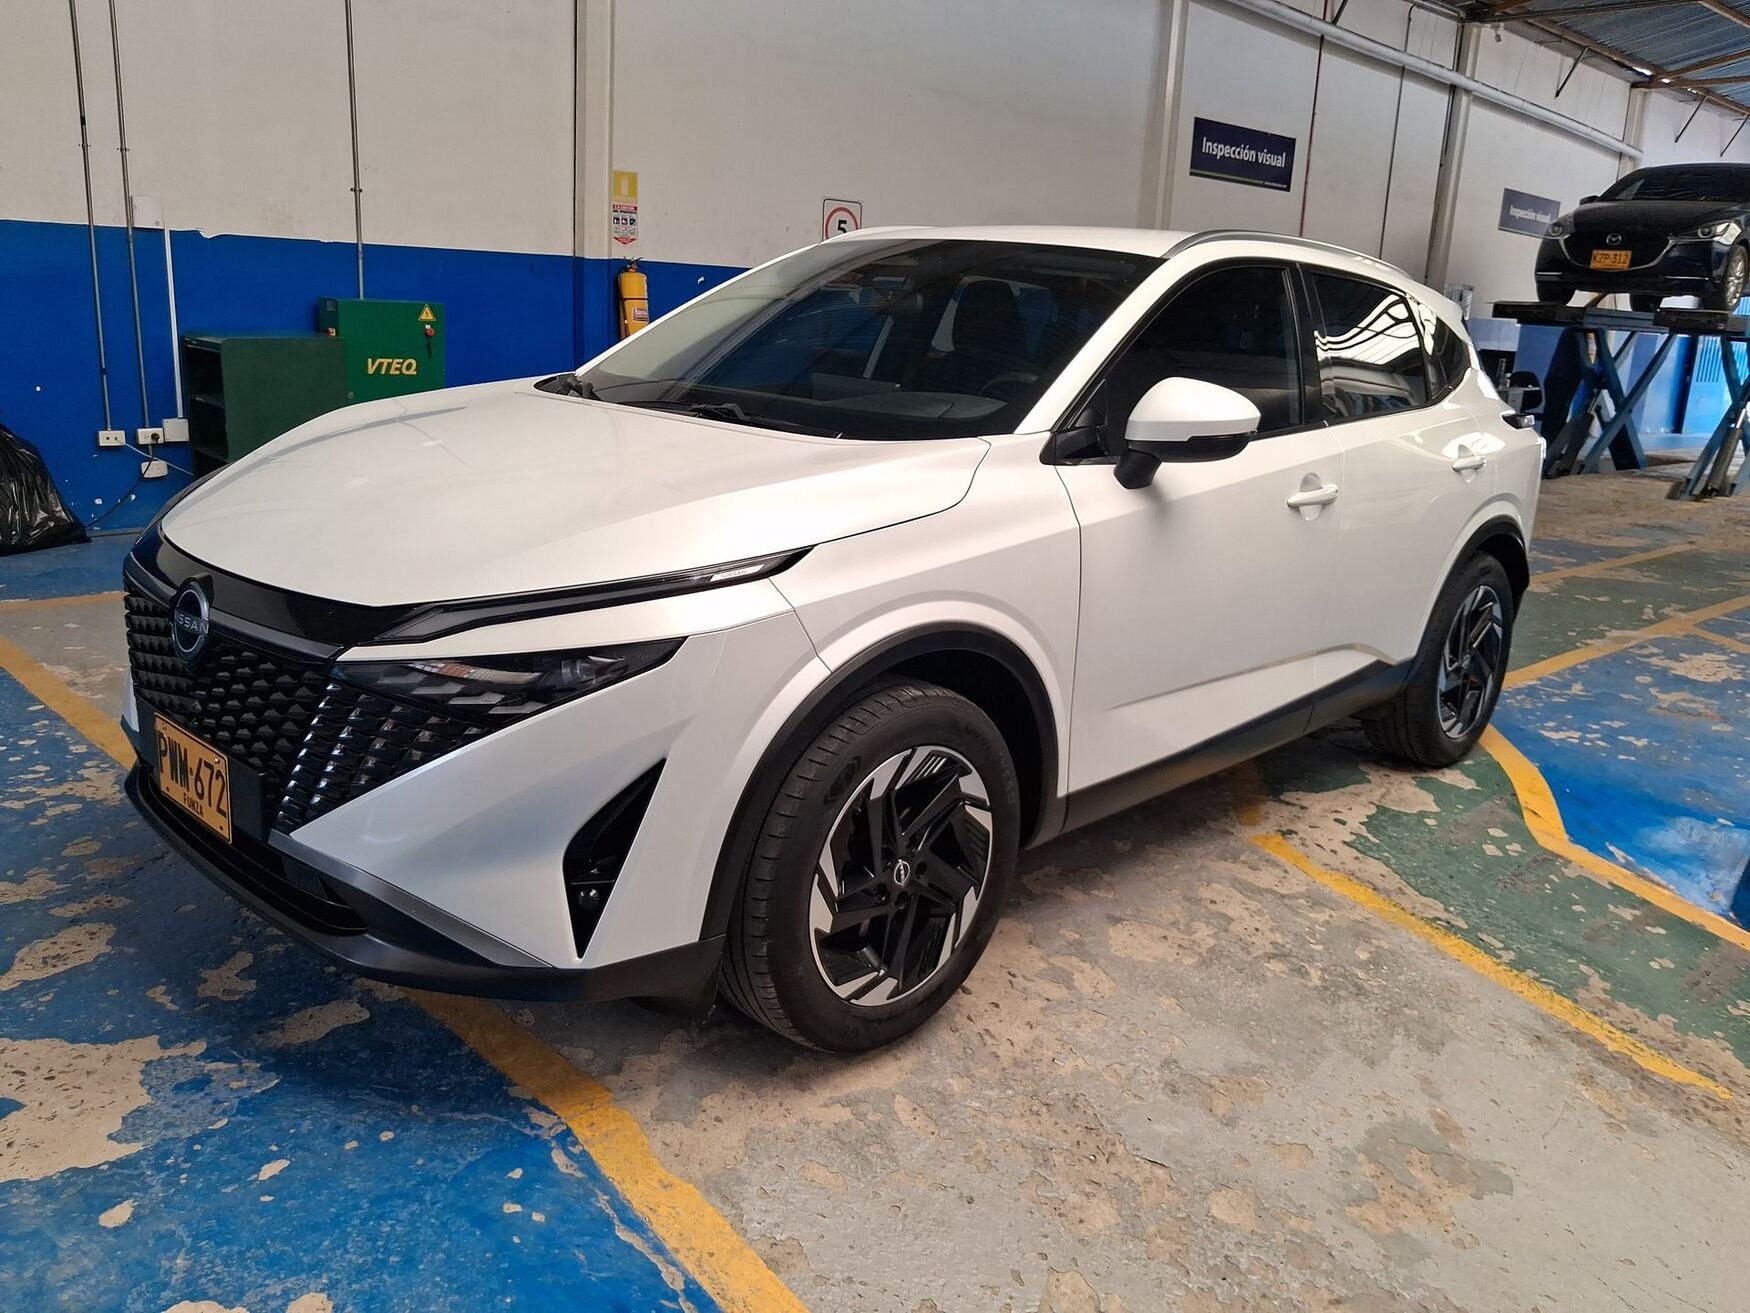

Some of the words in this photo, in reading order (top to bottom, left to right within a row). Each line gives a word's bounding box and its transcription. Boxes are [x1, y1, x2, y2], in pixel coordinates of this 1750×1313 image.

[1202, 137, 1256, 162] Inspección
[1258, 149, 1286, 168] visual
[837, 219, 848, 234] 5
[367, 358, 417, 375] VTEQ
[175, 606, 209, 634] ISSAN
